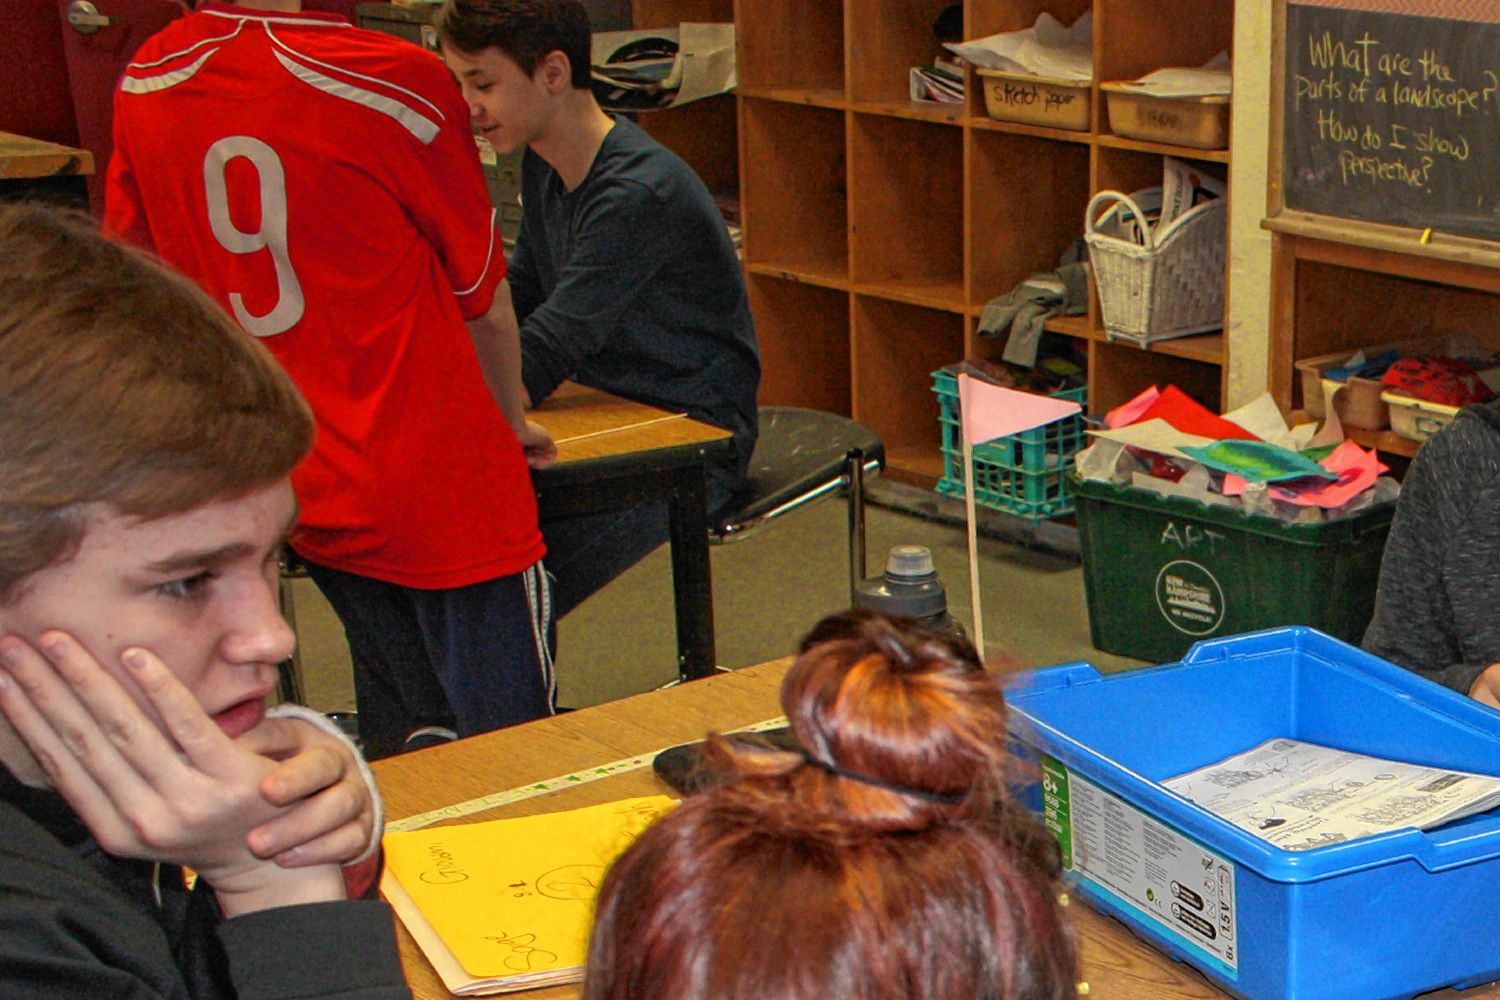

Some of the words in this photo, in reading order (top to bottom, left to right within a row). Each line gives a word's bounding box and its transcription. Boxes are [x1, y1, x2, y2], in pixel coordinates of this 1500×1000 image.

[1309, 31, 1379, 76] What
[1378, 52, 1413, 76] are
[1418, 50, 1455, 82] the
[1350, 79, 1370, 102] of
[1376, 85, 1387, 103] a
[1393, 71, 1498, 116] landscape?
[1317, 108, 1358, 142] How
[1361, 124, 1381, 150] do
[1389, 124, 1407, 149] I
[1416, 127, 1469, 160] show
[203, 135, 305, 337] 9
[1161, 520, 1226, 556] ART
